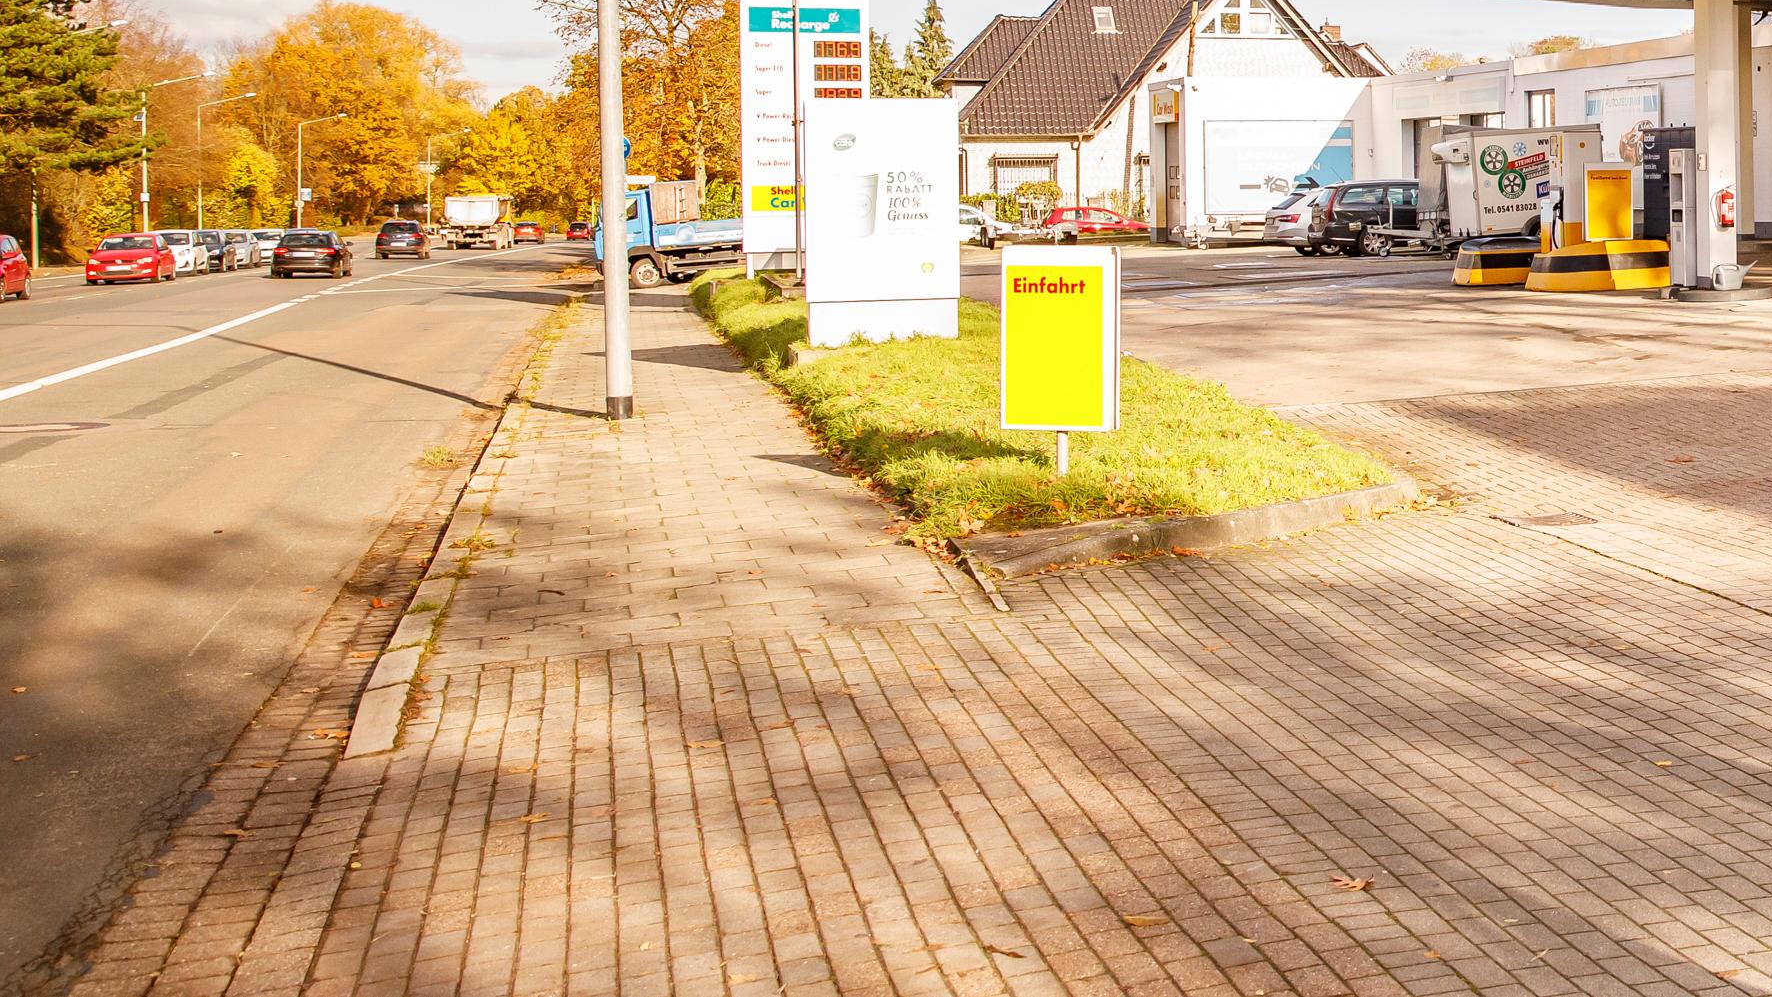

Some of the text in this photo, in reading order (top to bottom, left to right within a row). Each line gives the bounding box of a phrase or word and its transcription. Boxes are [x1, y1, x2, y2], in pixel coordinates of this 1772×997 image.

[771, 18, 831, 32] Recarge
[1514, 154, 1544, 168] STEINFELD
[886, 185, 933, 194] RABATT
[1484, 203, 1538, 214] Tel. 0541 83028
[887, 210, 929, 222] Genuss
[1013, 276, 1086, 293] Einfahrt
